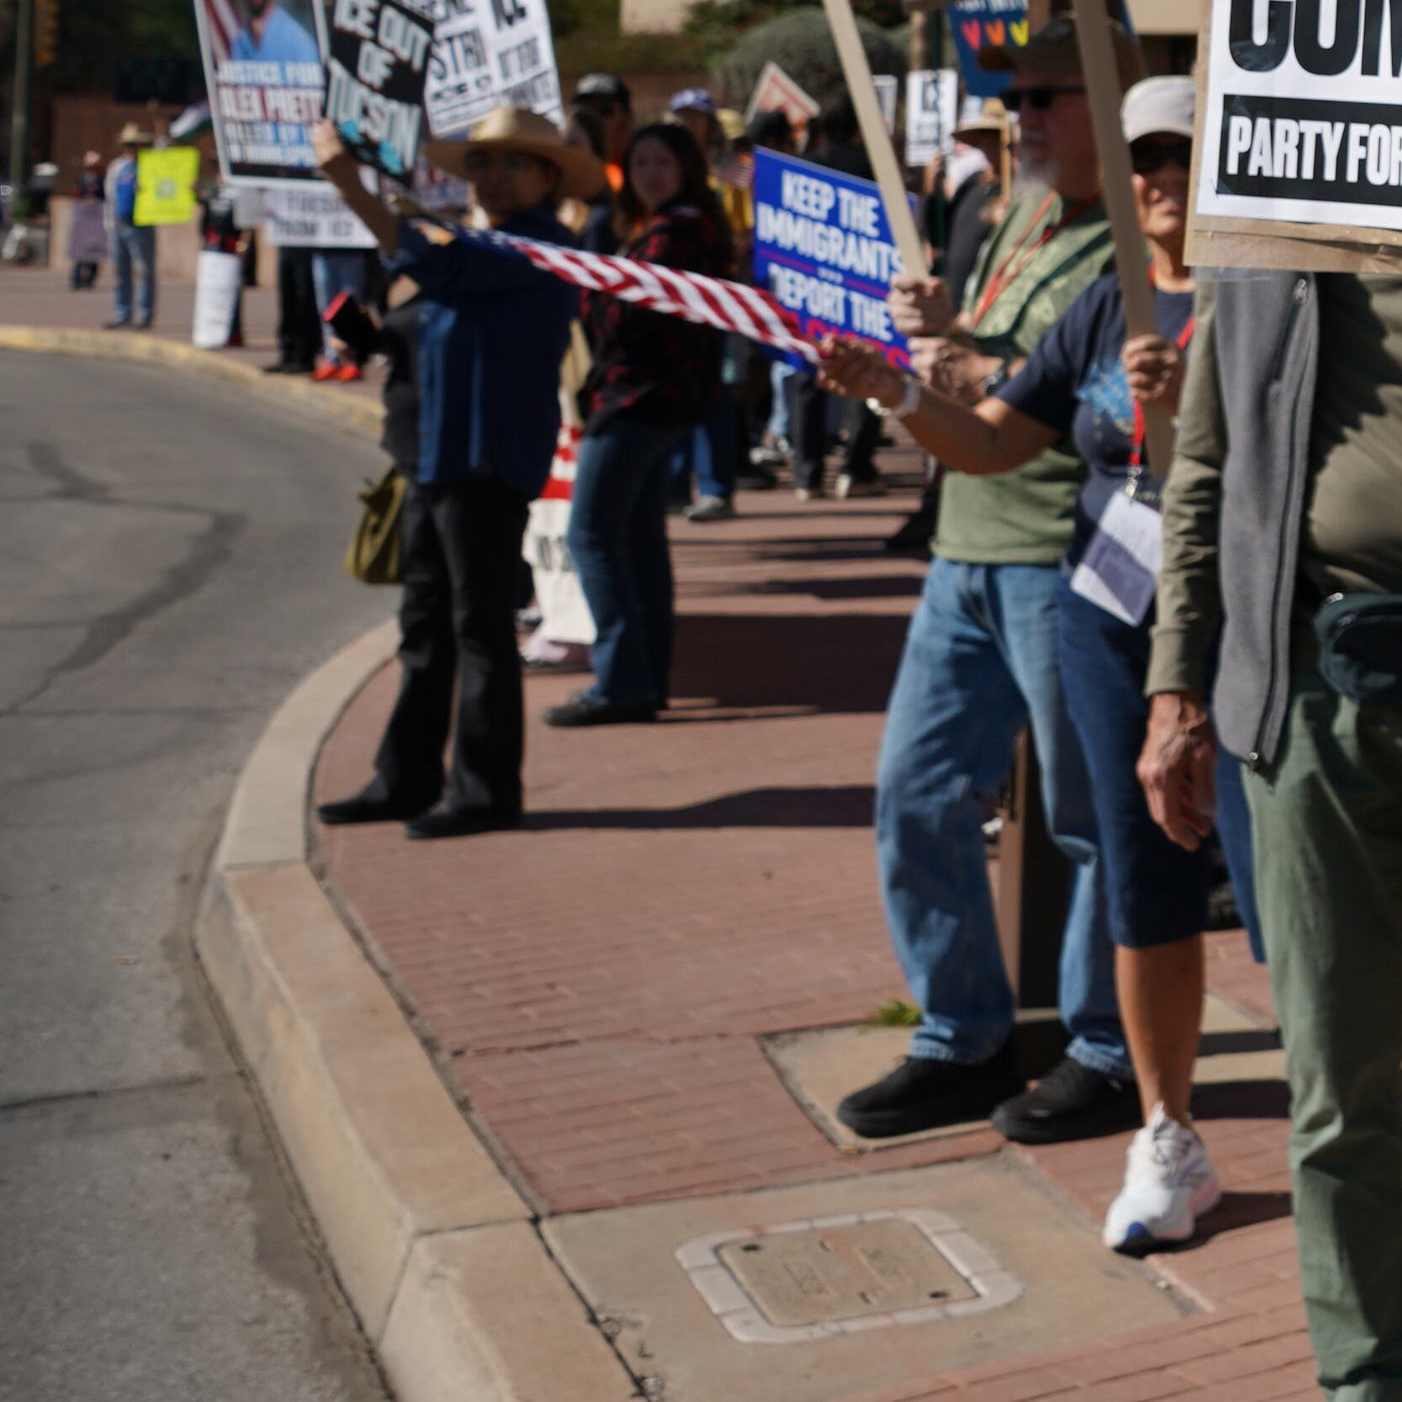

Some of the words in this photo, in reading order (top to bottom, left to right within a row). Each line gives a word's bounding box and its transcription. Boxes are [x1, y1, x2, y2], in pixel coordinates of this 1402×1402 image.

[357, 39, 397, 91] OF
[377, 2, 431, 72] OUT
[1227, 115, 1345, 181] PARTY
[782, 169, 835, 220] KEEP
[837, 187, 880, 237] THE
[756, 201, 905, 283] IMMIGRANTS
[848, 290, 893, 341] THE
